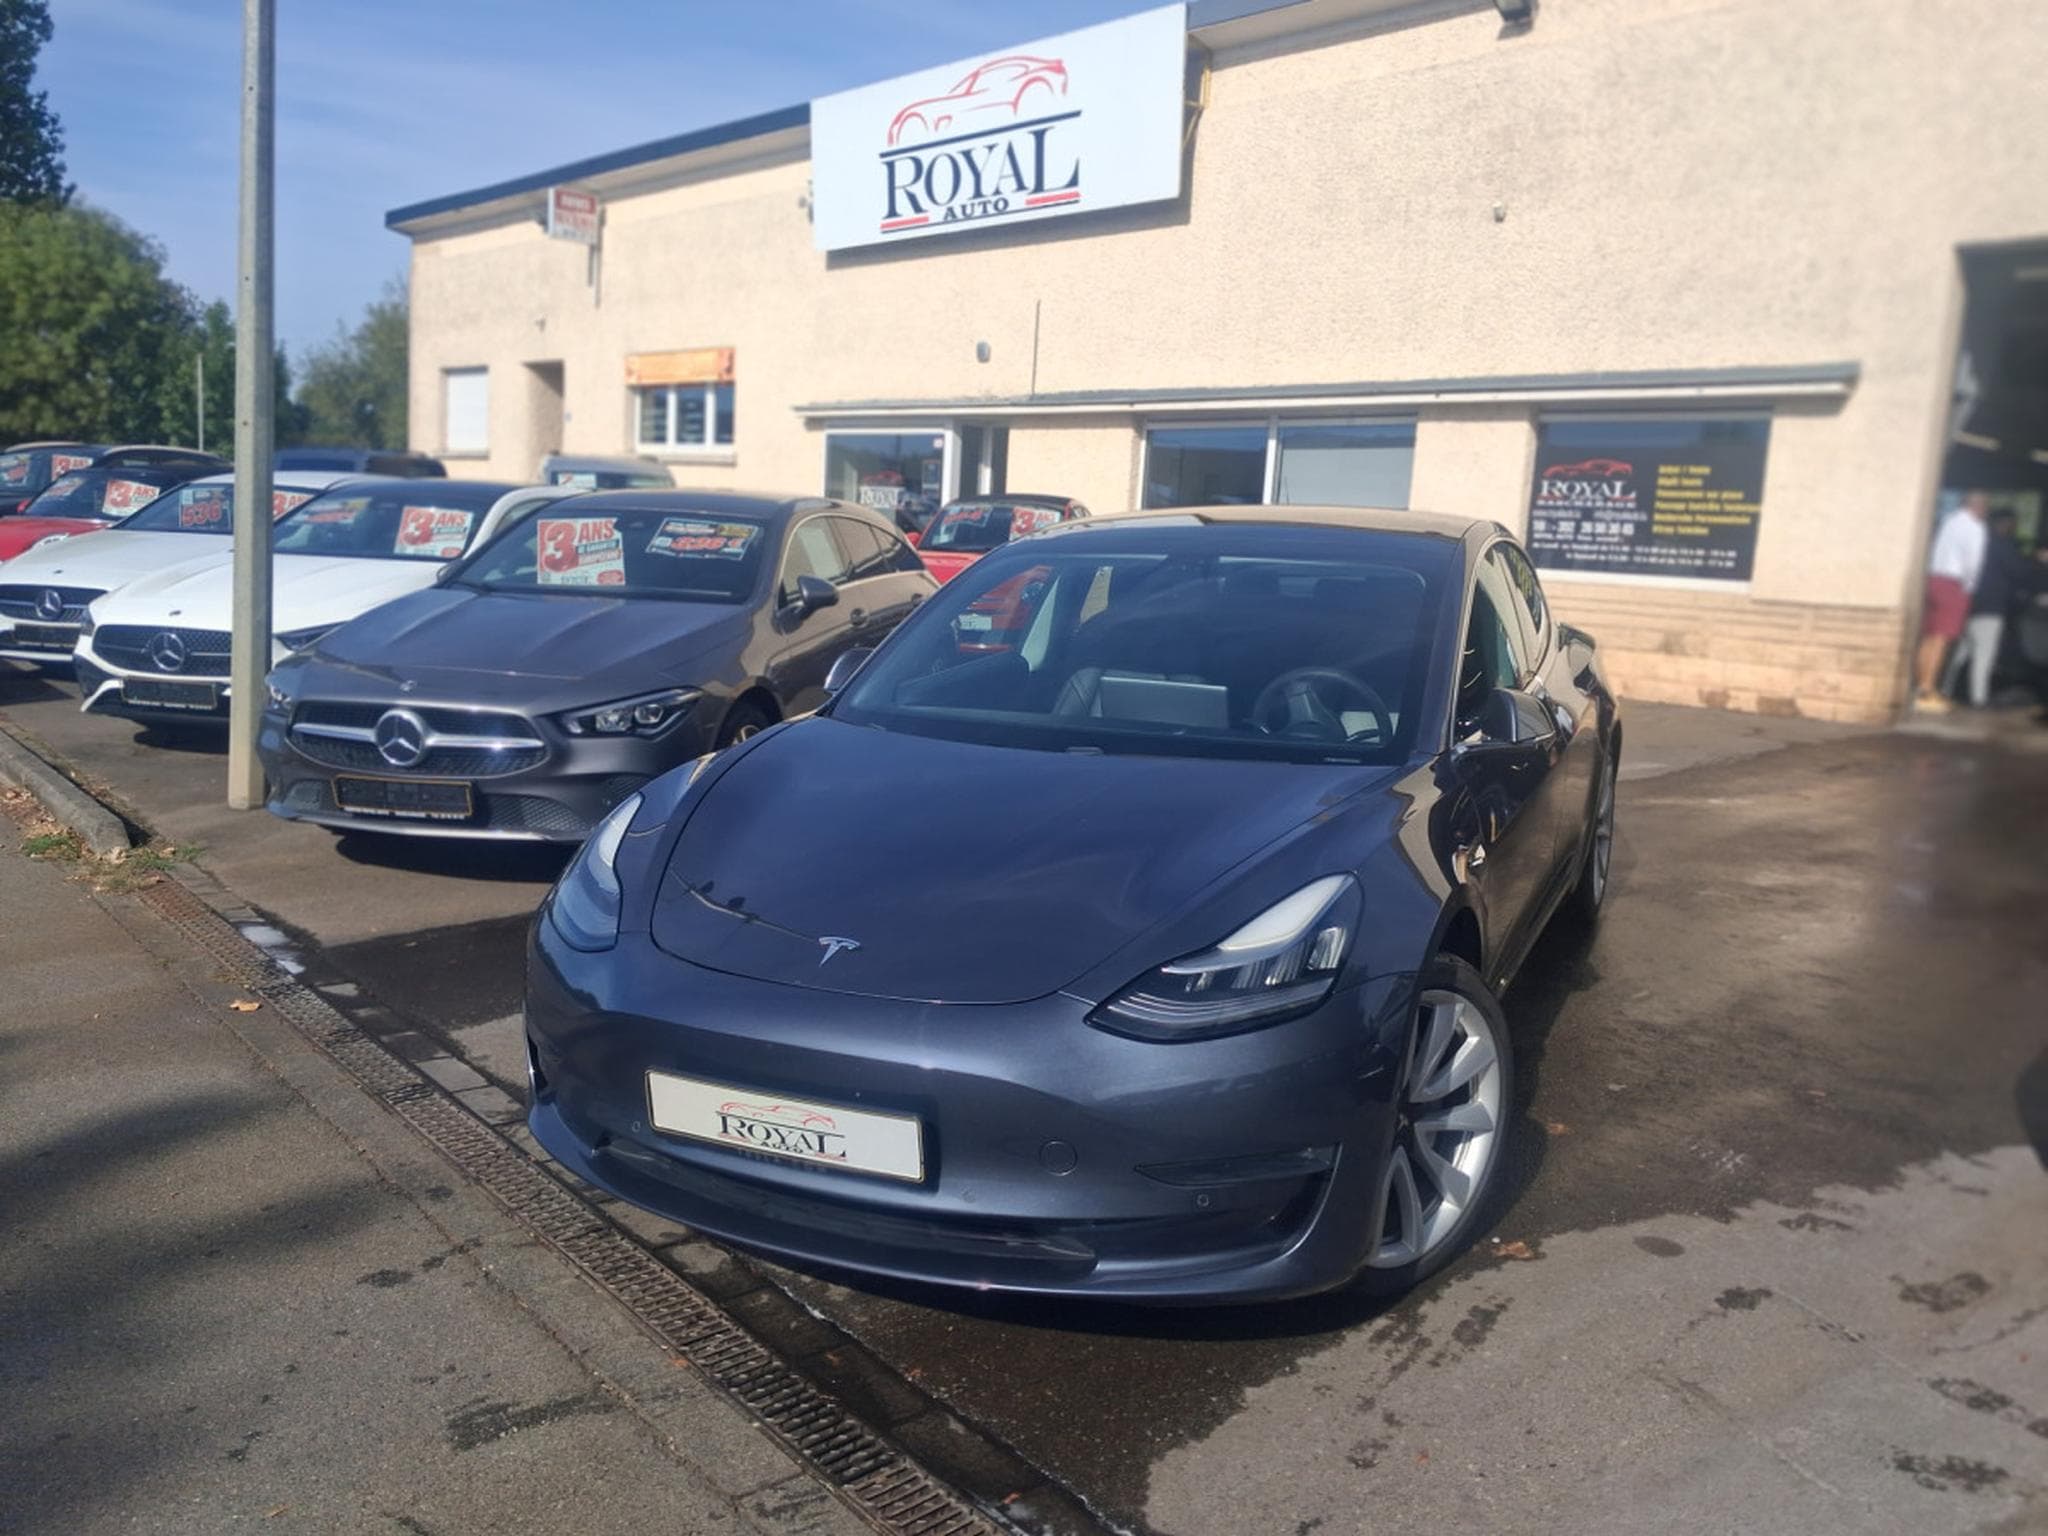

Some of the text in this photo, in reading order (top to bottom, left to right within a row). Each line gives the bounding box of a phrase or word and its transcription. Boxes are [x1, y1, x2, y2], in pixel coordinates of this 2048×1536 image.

[880, 126, 1080, 220] ROYAL
[942, 197, 1009, 222] AUTO
[107, 480, 133, 508] 3
[1540, 480, 1637, 498] ROYAL
[401, 507, 466, 546] 3 ANS
[1011, 506, 1035, 535] 3
[544, 521, 580, 574] 3
[578, 519, 615, 544] ANS
[720, 1115, 848, 1158] ROYAL
